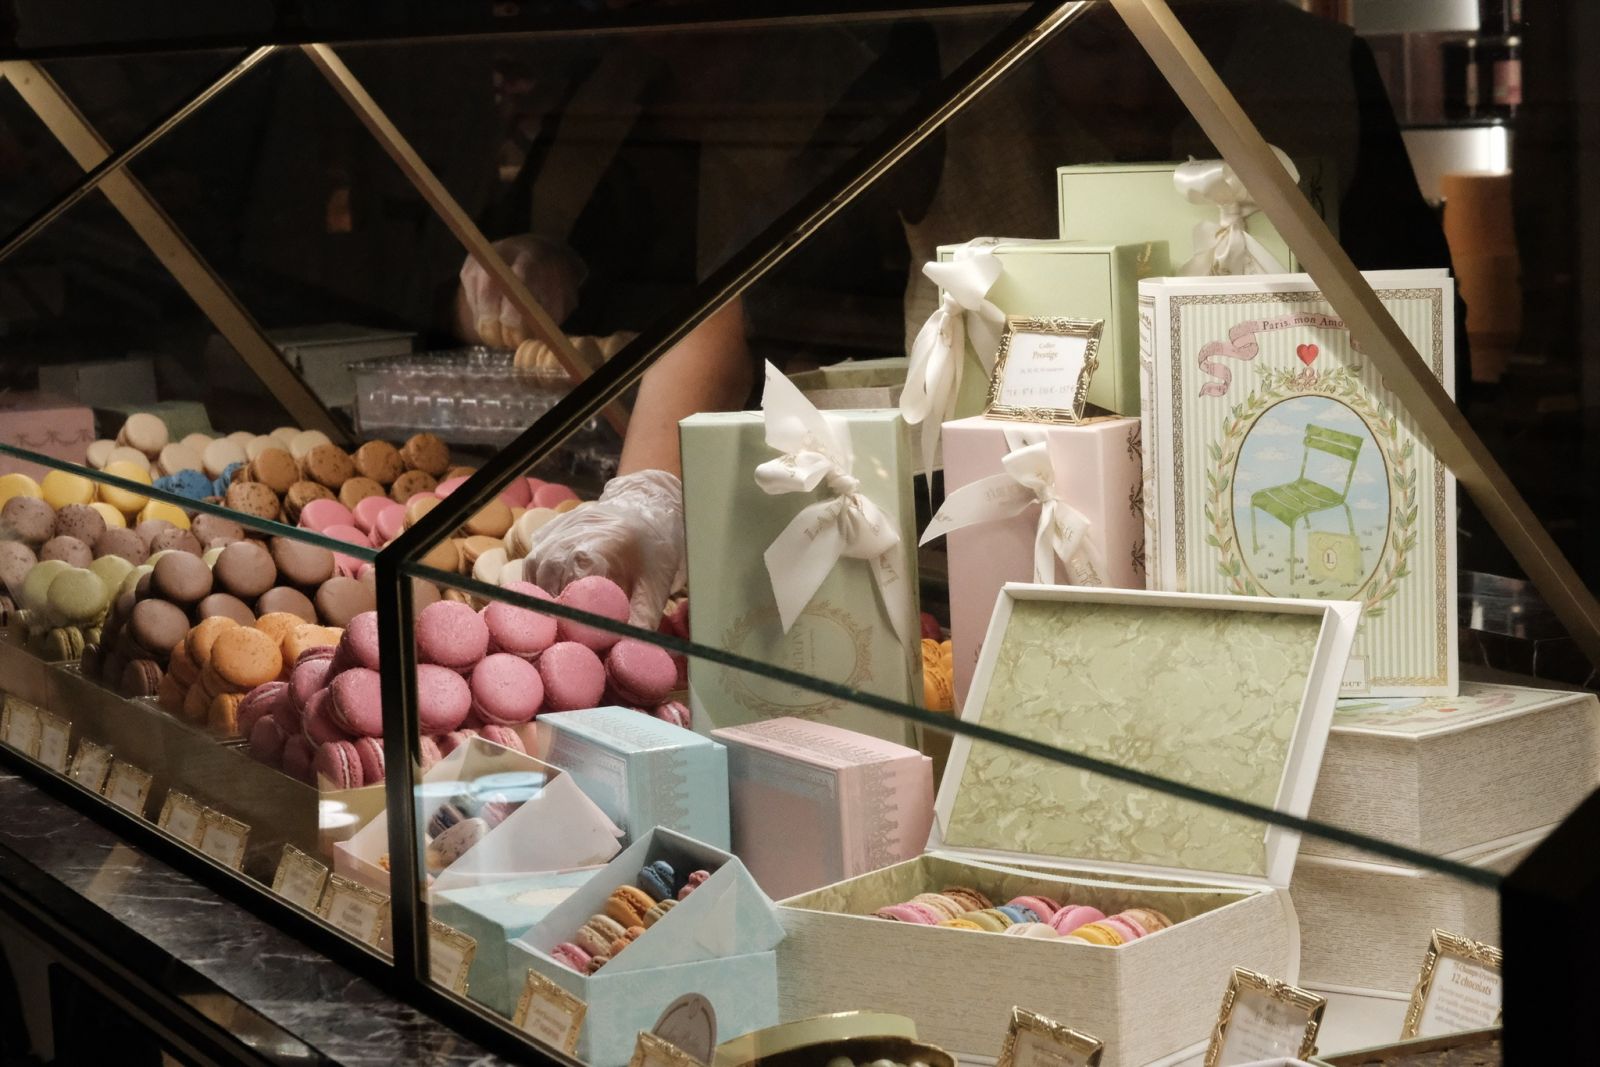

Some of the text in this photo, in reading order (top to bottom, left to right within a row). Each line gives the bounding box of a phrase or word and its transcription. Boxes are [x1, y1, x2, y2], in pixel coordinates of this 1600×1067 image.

[1294, 316, 1316, 325] mon
[1320, 317, 1344, 328] Amo
[1327, 553, 1334, 563] L
[1451, 973, 1460, 984] 12
